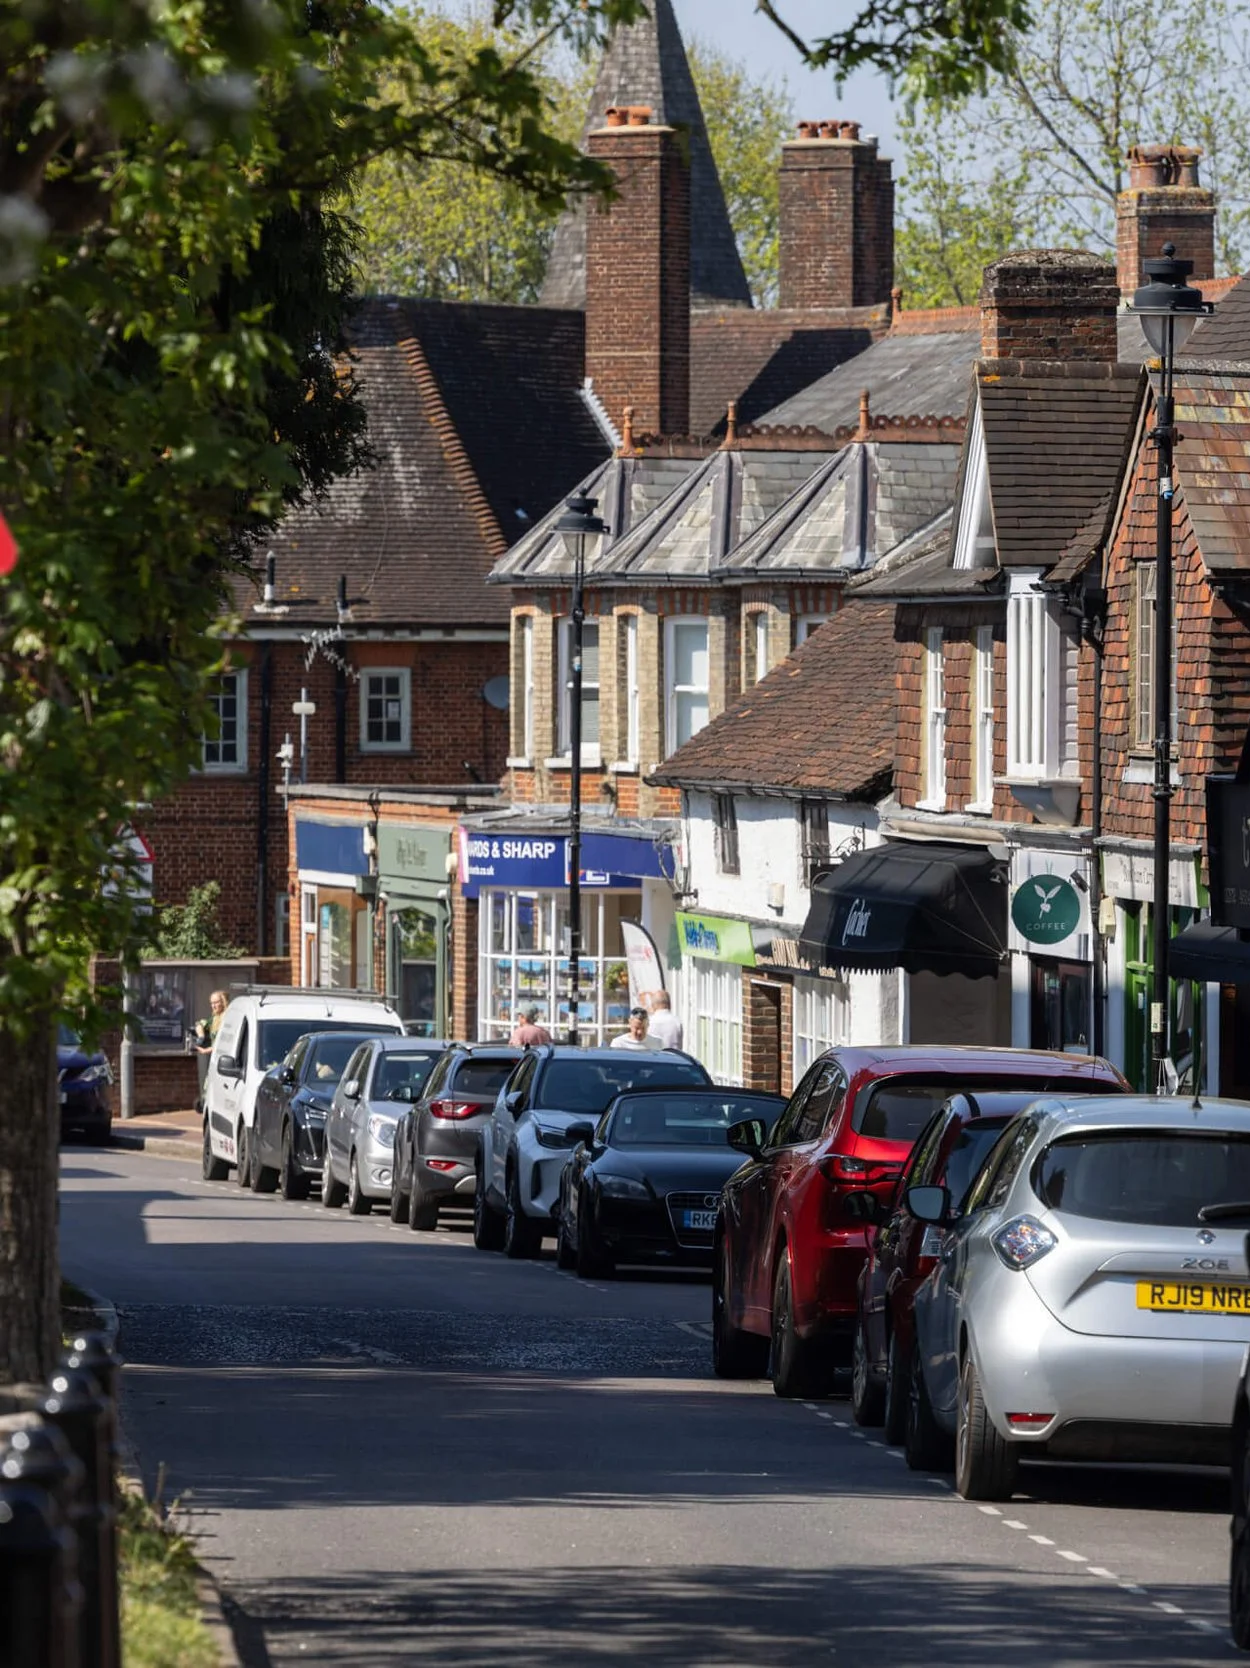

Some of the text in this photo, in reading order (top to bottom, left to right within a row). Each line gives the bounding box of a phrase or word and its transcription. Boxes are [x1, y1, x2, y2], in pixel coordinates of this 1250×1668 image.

[491, 841, 501, 858] &
[502, 841, 556, 859] SHARP
[1025, 922, 1066, 932] COFFEE
[1181, 1258, 1229, 1270] ZOE
[1151, 1283, 1204, 1306] RJ19
